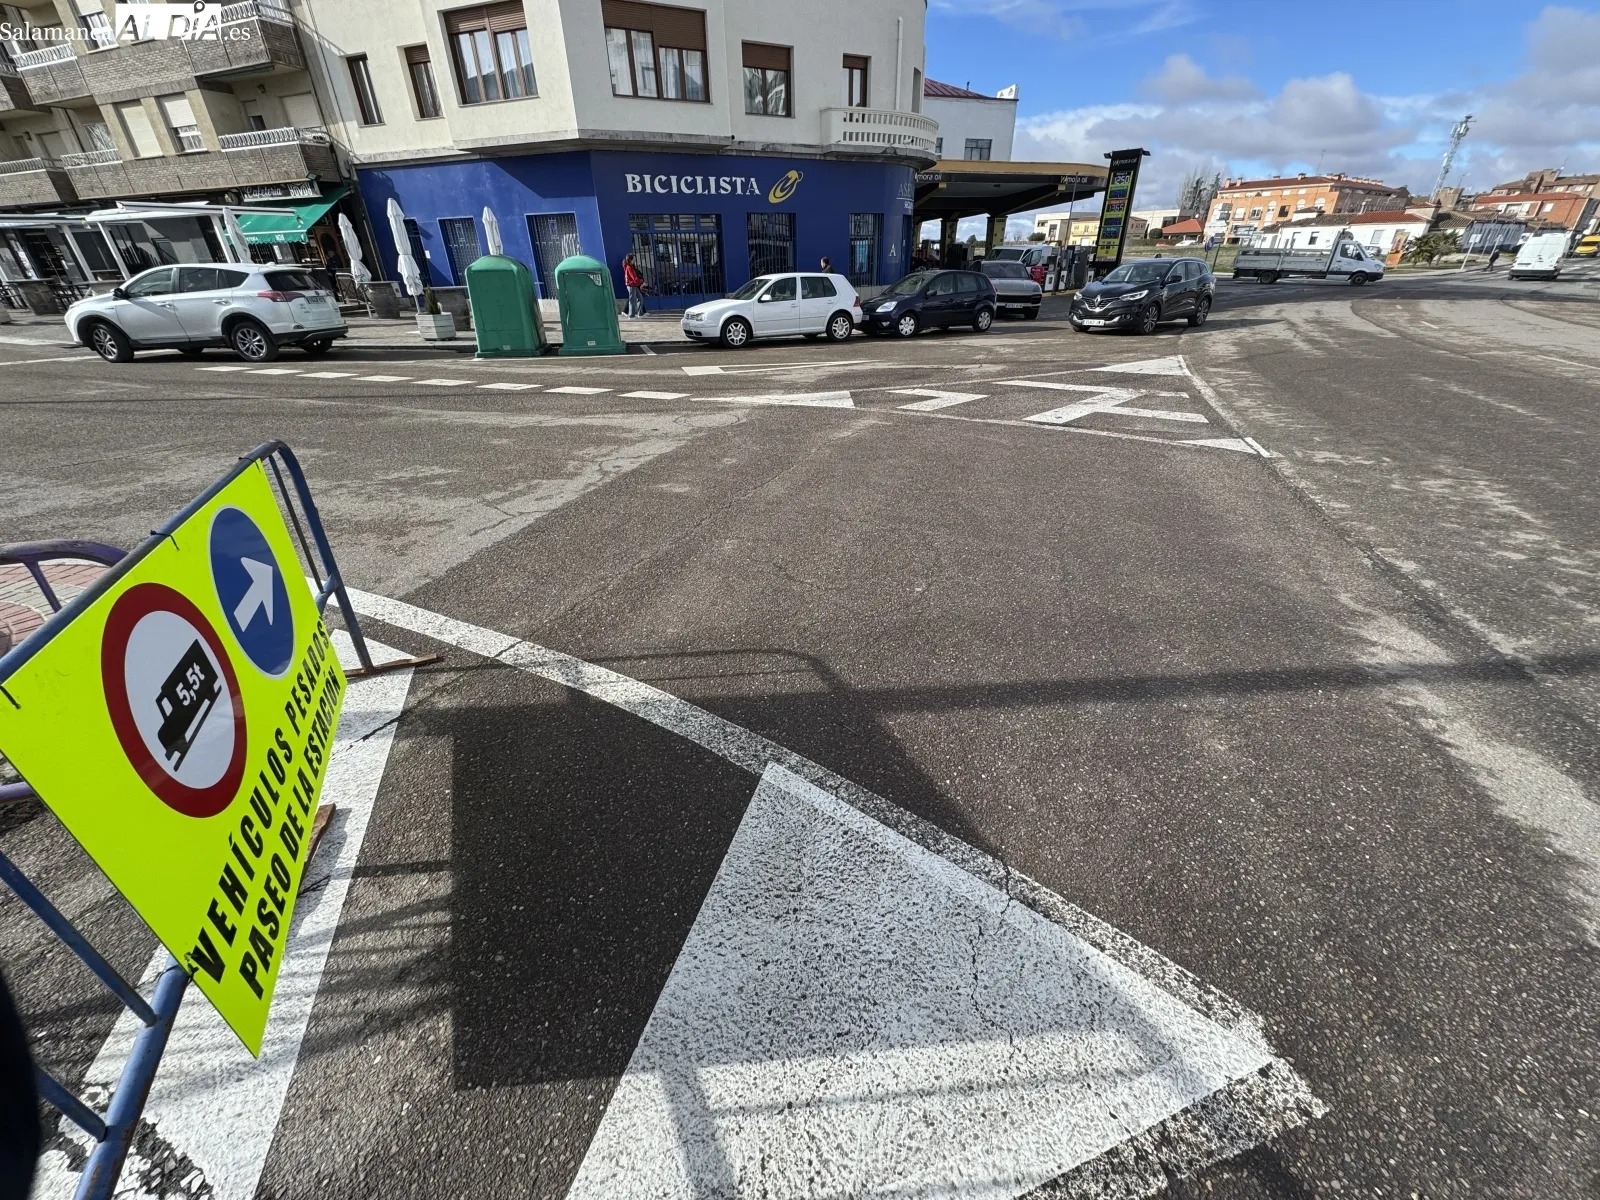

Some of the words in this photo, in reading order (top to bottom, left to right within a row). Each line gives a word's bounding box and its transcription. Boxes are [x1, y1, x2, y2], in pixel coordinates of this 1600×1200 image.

[624, 173, 762, 196] BICICLISTA
[175, 661, 206, 707] 5,5t
[303, 664, 342, 781] ESTACIÓN
[190, 727, 293, 985] VEHÍCULOS
[284, 617, 331, 738] PESADOS
[292, 766, 315, 818] LA
[279, 802, 305, 864] DE
[238, 852, 292, 1002] PASEO
